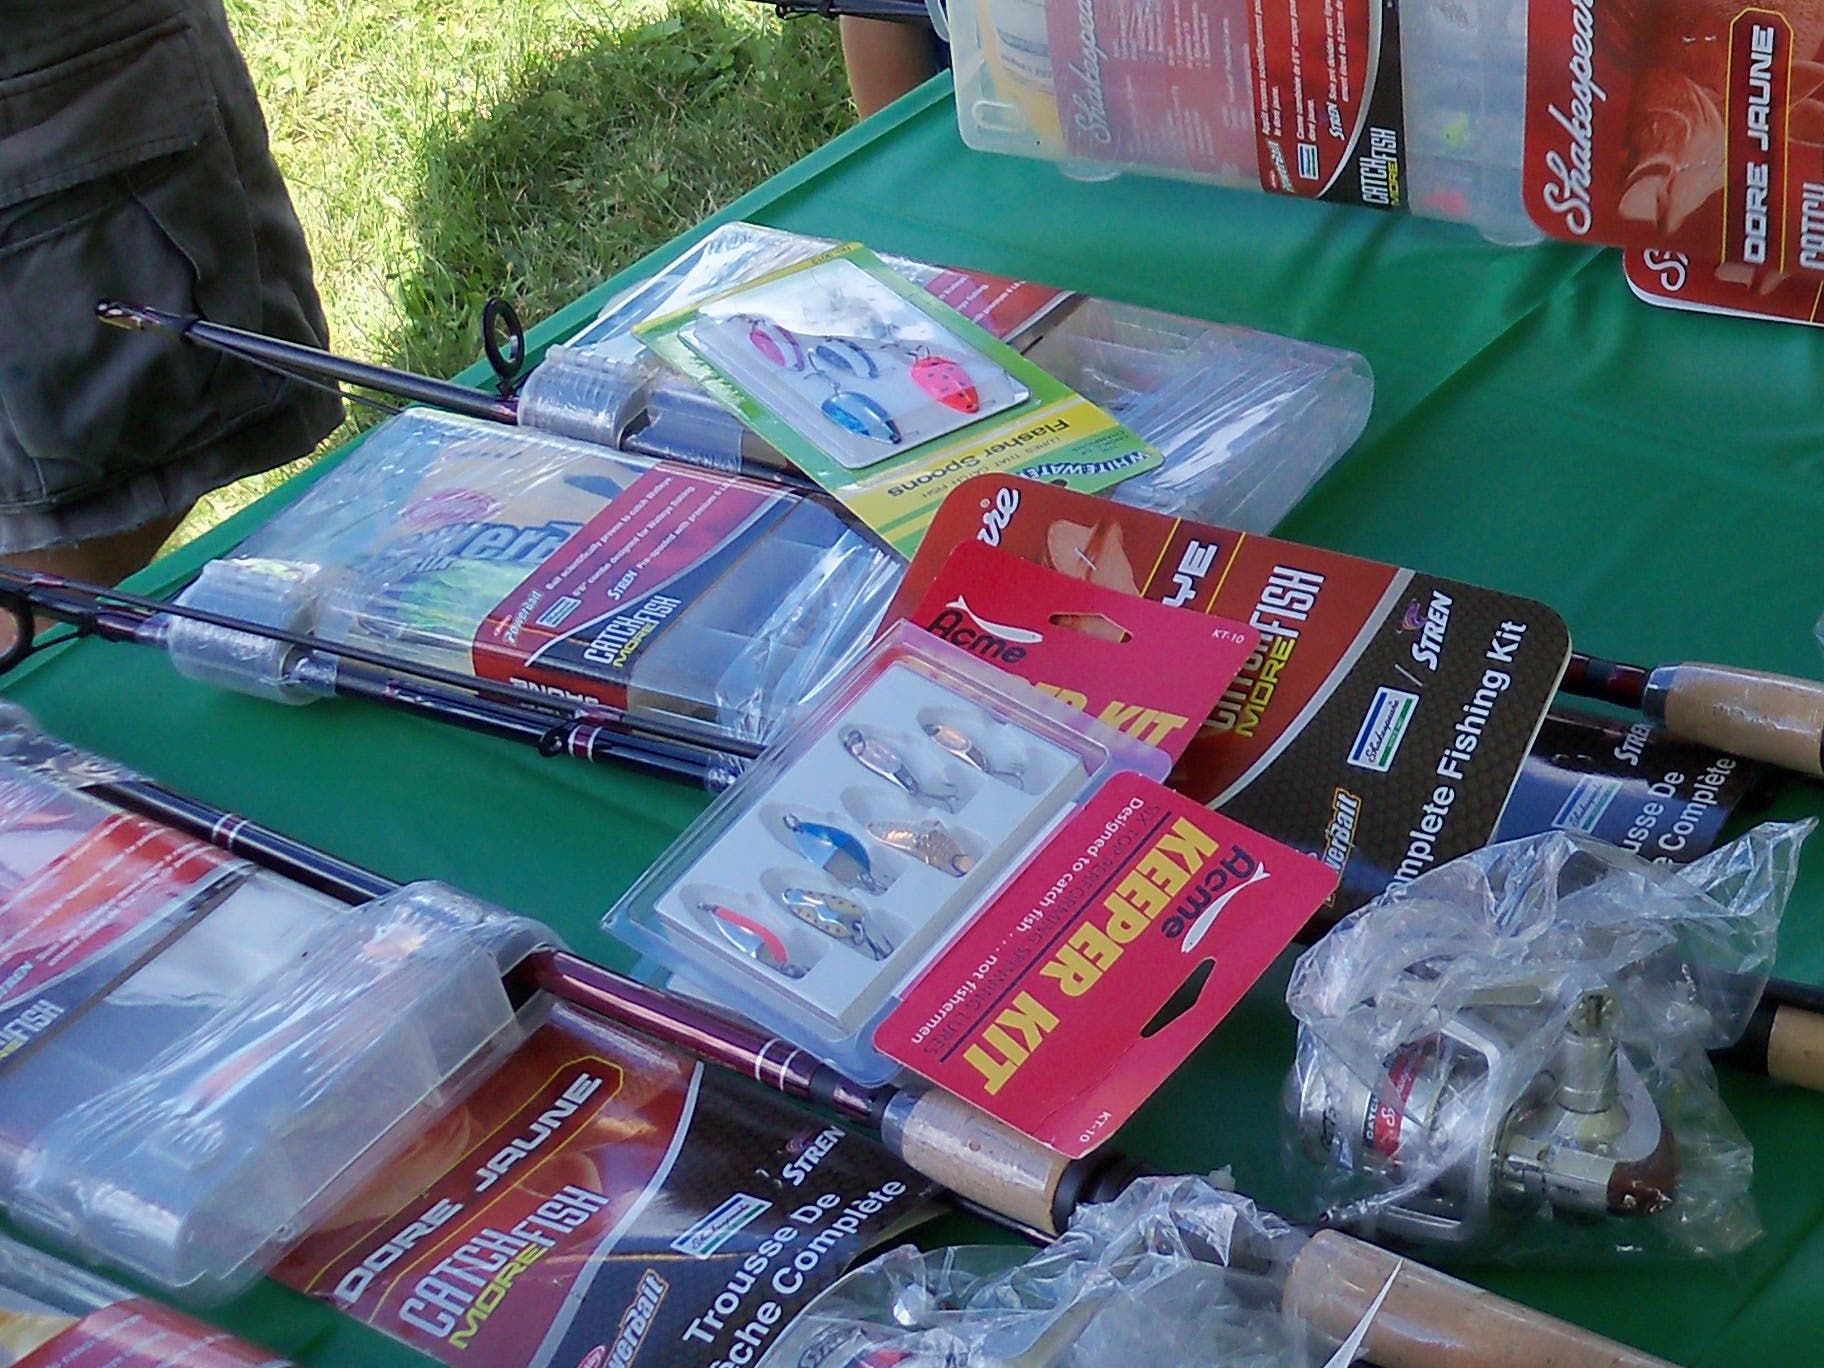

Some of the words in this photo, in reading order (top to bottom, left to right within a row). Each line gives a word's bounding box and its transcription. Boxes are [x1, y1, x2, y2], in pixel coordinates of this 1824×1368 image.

[1746, 23, 1776, 152] JAUNE
[1369, 126, 1398, 162] FISH
[1359, 156, 1390, 205] CATCH
[1387, 161, 1400, 207] MORE
[1743, 160, 1769, 265] DORE
[984, 418, 1070, 457] Flasher
[887, 454, 982, 498] Spoons
[607, 568, 640, 602] STREN
[1249, 564, 1327, 639] FISH
[583, 615, 639, 665] CATCH
[635, 594, 683, 629] FISH
[612, 620, 658, 669] MORE
[926, 609, 1028, 664] Acme
[1211, 627, 1245, 645] KT-10
[1411, 589, 1454, 671] STREN
[1234, 637, 1297, 738] MORE
[1436, 668, 1512, 780] Fishing
[1486, 619, 1528, 664] Kit
[1614, 721, 1652, 766] STRE
[1086, 797, 1145, 859] Designed
[1621, 801, 1665, 855] usse
[1647, 770, 1686, 799] De
[1658, 757, 1737, 851] Complète
[1016, 908, 1045, 934] fish
[1039, 816, 1221, 998] KEEPER
[1040, 863, 1078, 909] catch
[1160, 844, 1256, 940] Acme
[973, 954, 1000, 982] not
[911, 976, 977, 1045] fishermen
[963, 990, 1060, 1096] KIT
[781, 1125, 846, 1187] STREN
[1080, 1110, 1111, 1145] KT-10
[333, 1197, 465, 1304] DORE
[475, 1072, 604, 1194] JAUNE
[399, 1227, 530, 1339] CATCH
[511, 1184, 610, 1249] FISH
[682, 1224, 799, 1345] Trousse
[790, 1191, 841, 1225] De
[708, 1299, 782, 1368] che
[771, 1180, 907, 1297] Complète
[449, 1243, 550, 1351] MORE
